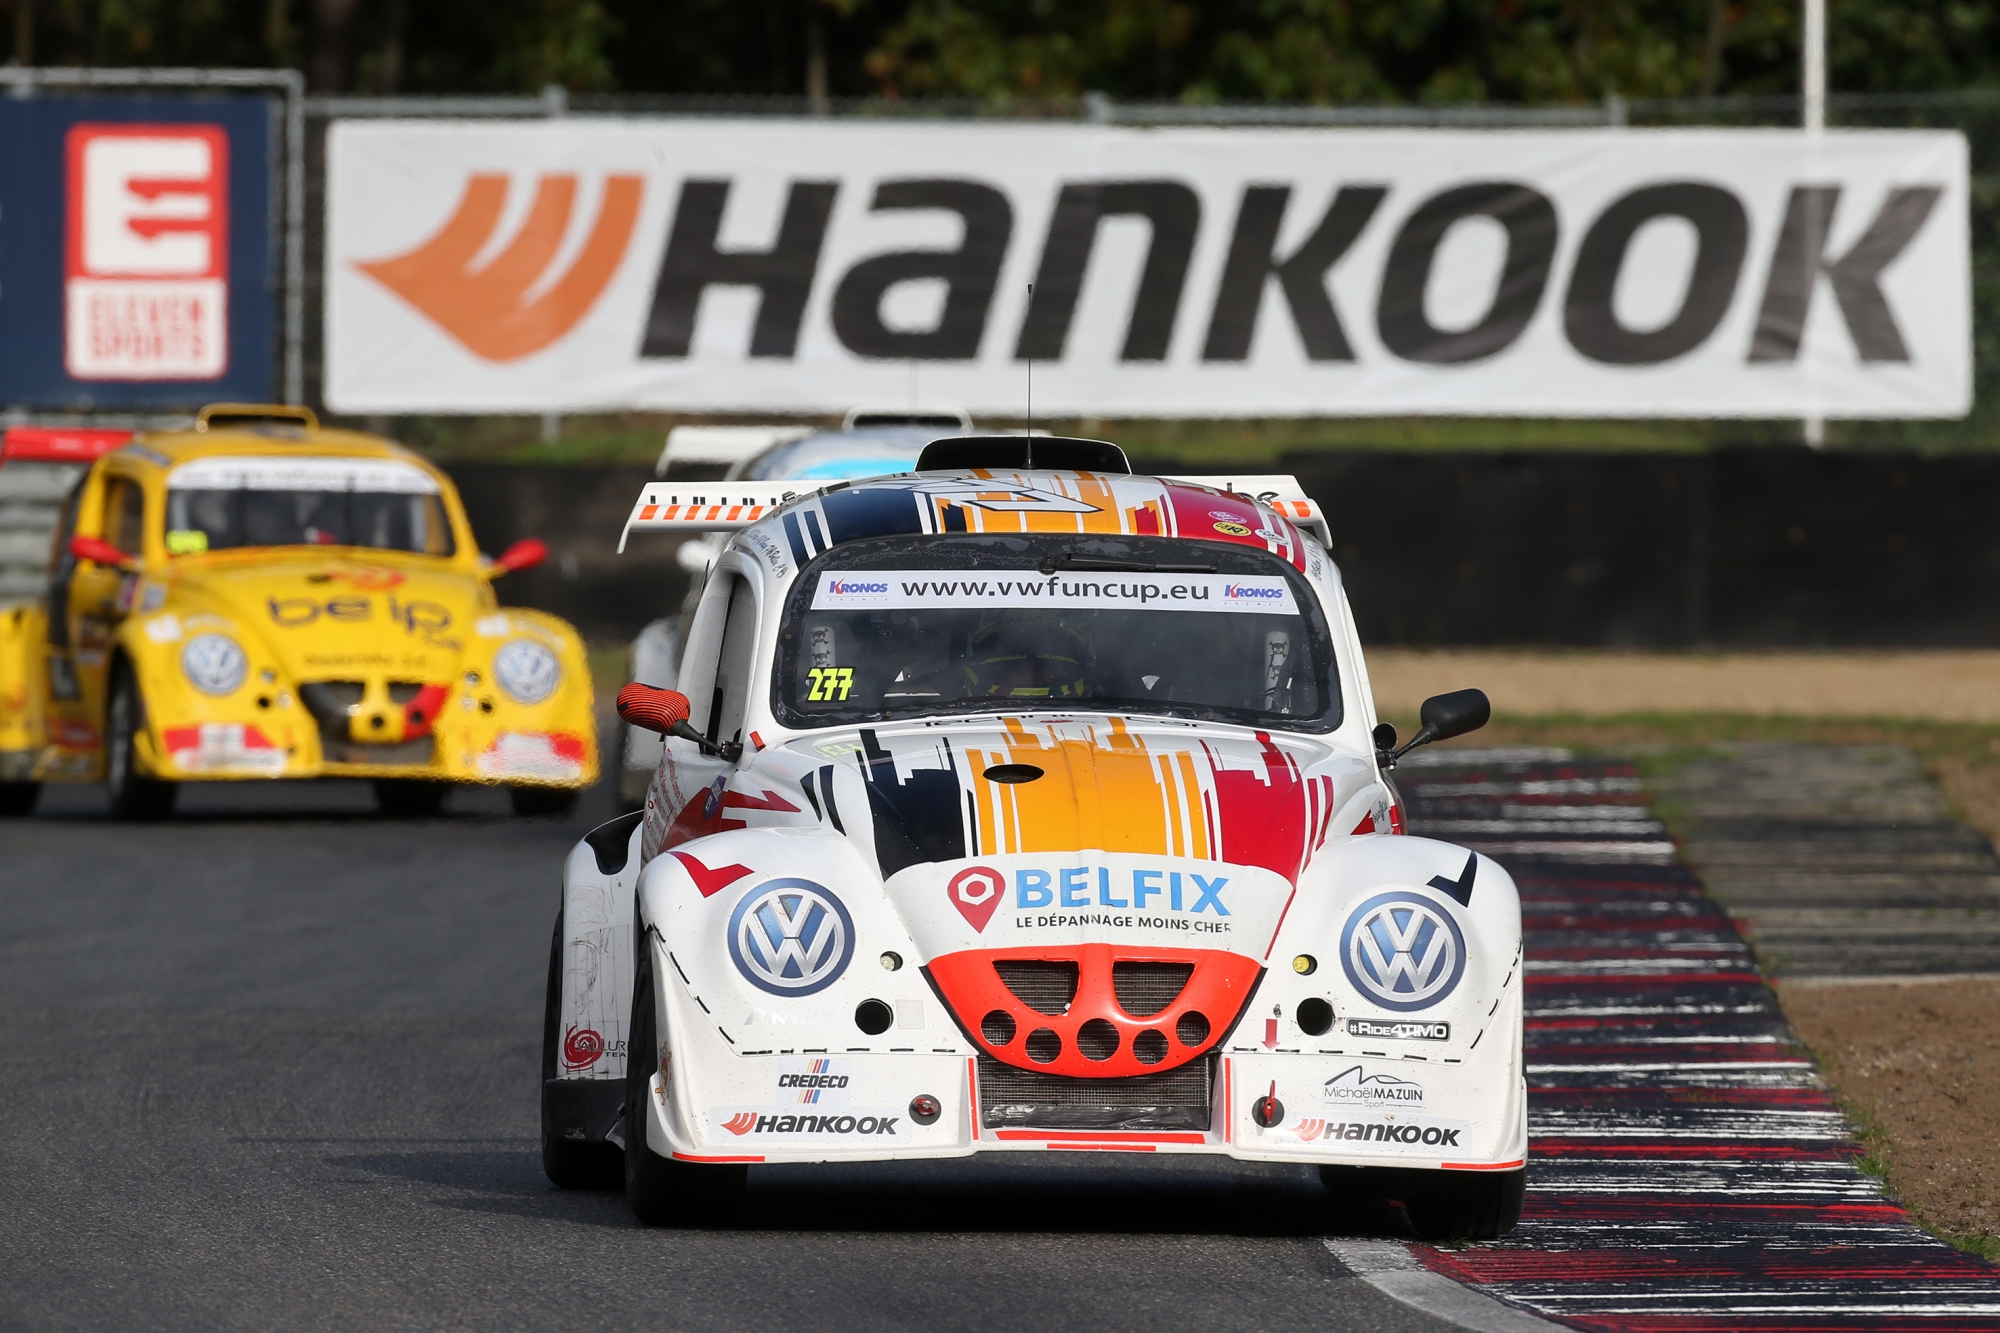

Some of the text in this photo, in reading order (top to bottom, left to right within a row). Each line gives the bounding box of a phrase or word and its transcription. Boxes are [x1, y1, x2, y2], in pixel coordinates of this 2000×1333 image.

[829, 576, 1283, 603] KRONOS www.vwfuncup.eu KRONOS
[807, 666, 855, 701] 277
[1016, 867, 1231, 916] BELFIX
[1016, 916, 1033, 928] LE
[1037, 912, 1133, 928] DÉPANNAGE
[1138, 917, 1190, 930] MOINS
[778, 1074, 849, 1089] CREDECO
[1364, 1099, 1384, 1109] Sport
